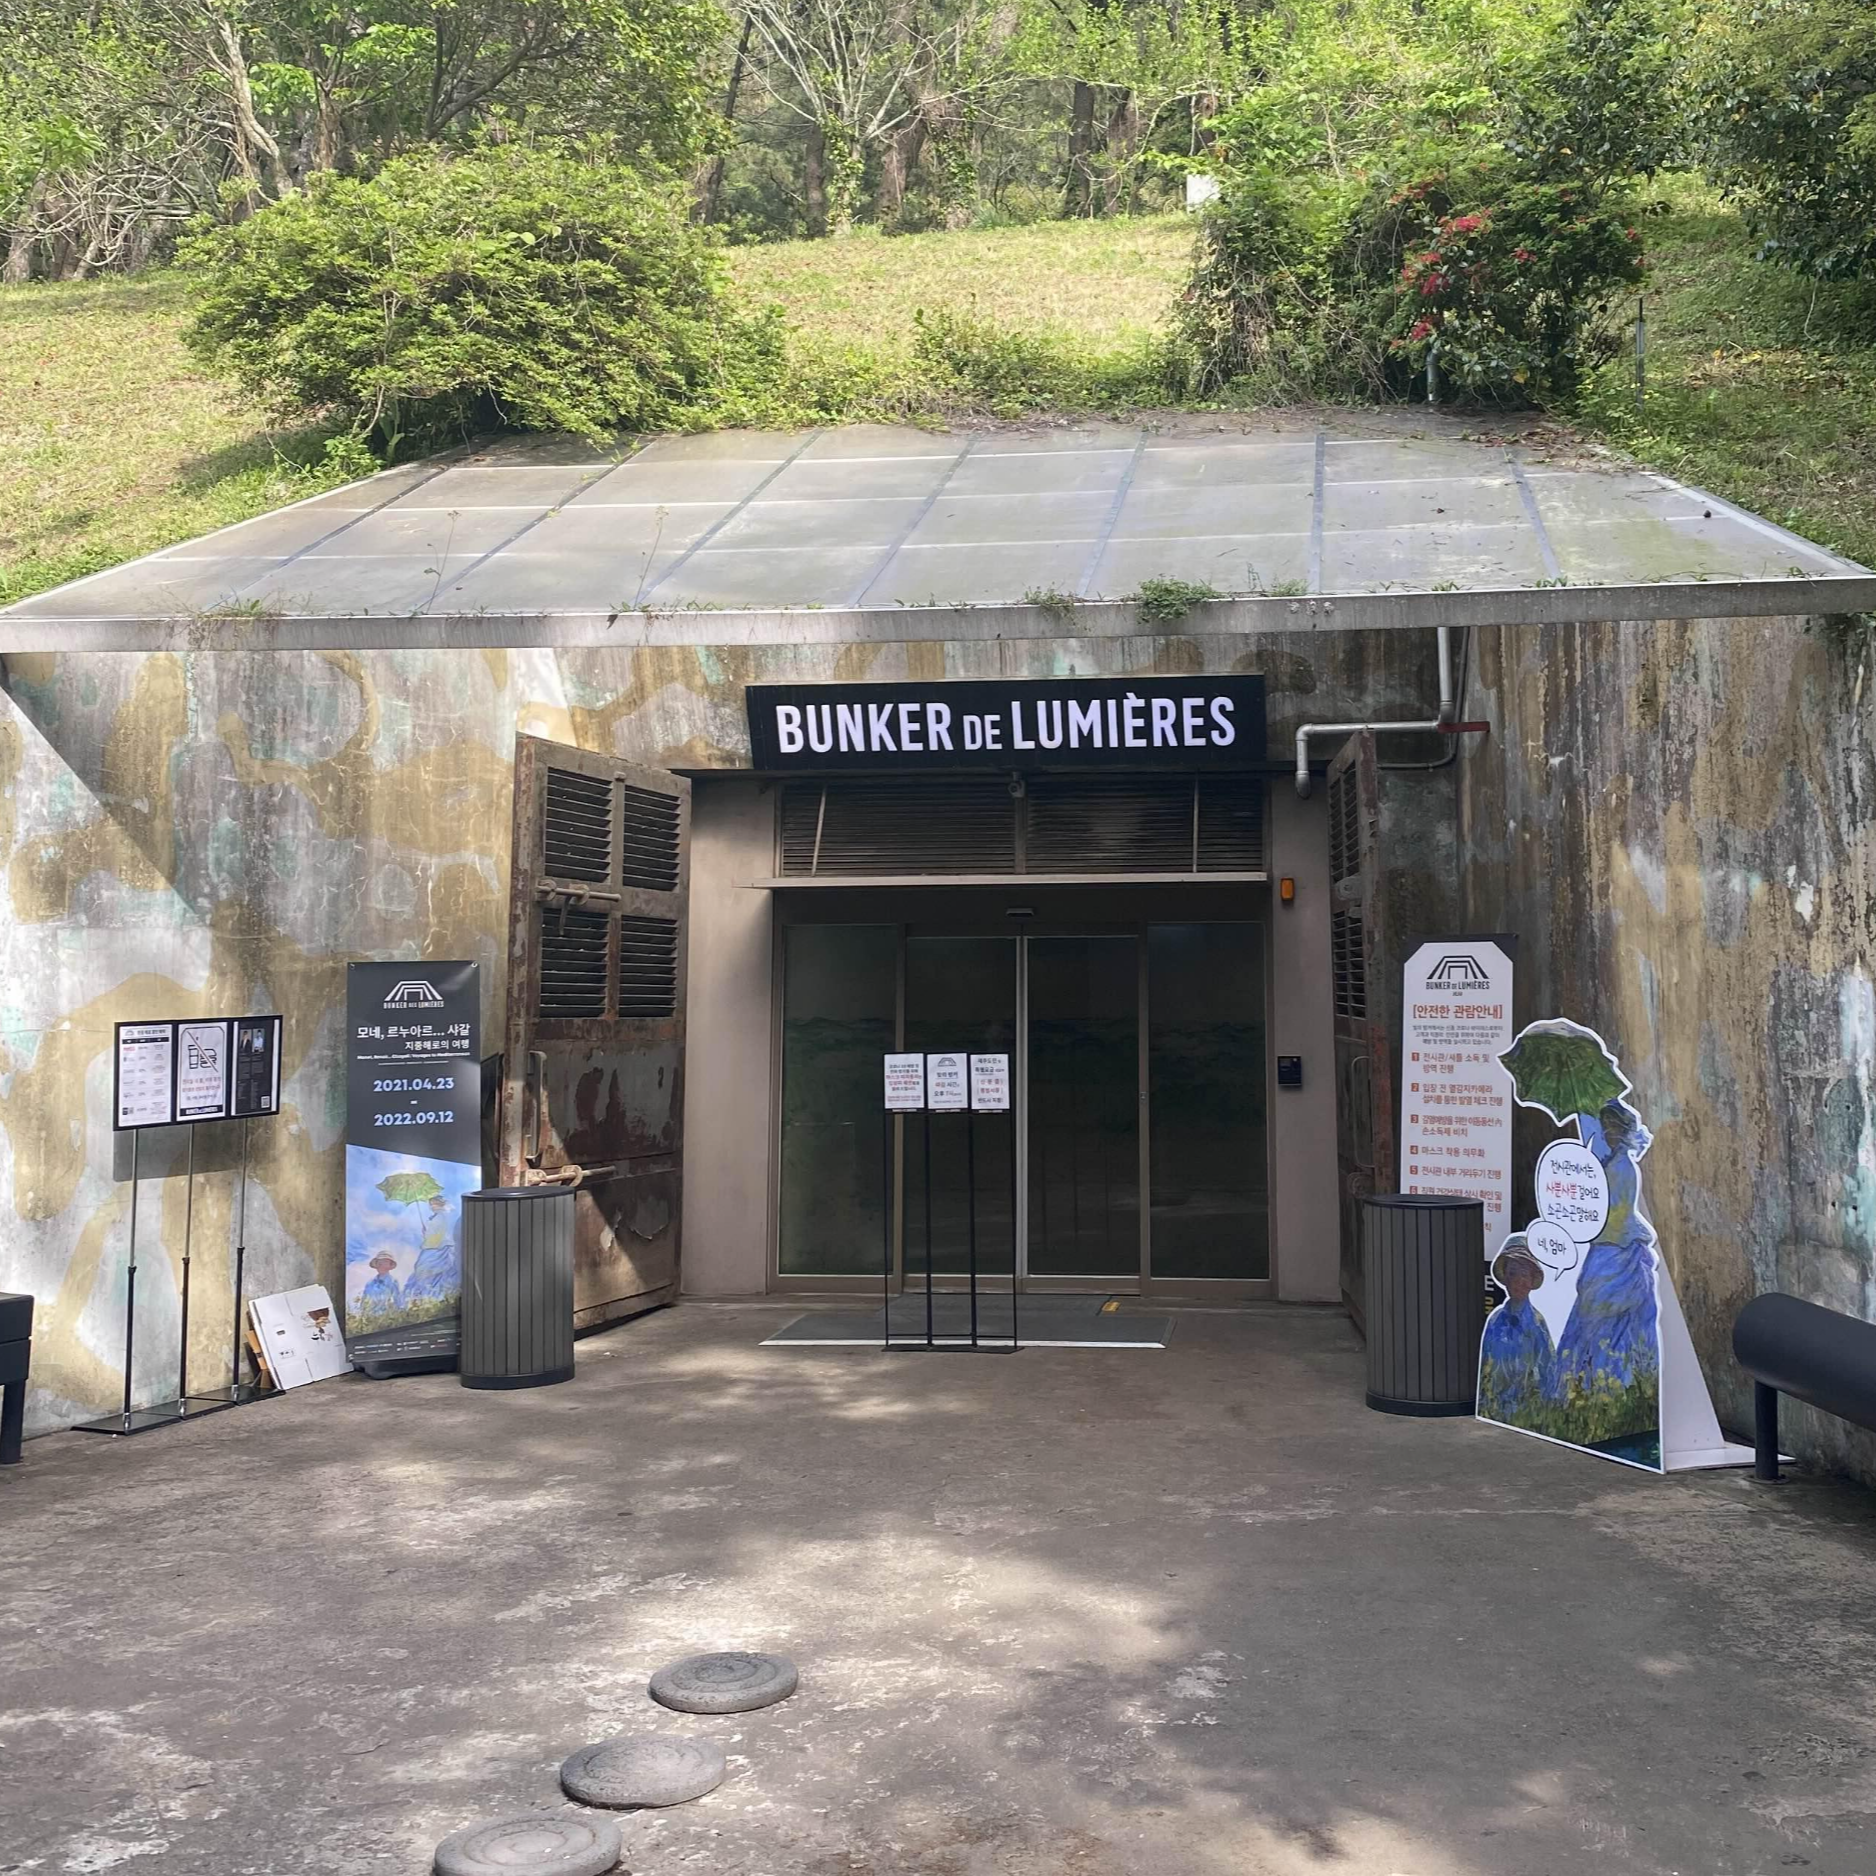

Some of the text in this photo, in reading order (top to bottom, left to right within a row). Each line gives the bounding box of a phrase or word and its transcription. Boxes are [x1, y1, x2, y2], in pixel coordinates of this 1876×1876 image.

[775, 692, 1236, 753] BUNKER DE LUMIÈRES
[1426, 982, 1450, 990] BUNKER
[1458, 980, 1490, 990] LUMIÈRES
[1413, 1004, 1503, 1020] [안전한 관람안내]
[357, 1023, 471, 1040] 모네, 르누아르... 샤갈
[404, 1039, 470, 1050] 지중해로의 여행
[1465, 1053, 1480, 1063] 소독
[1482, 1054, 1490, 1063] 및
[1439, 1064, 1454, 1074] 진행
[373, 1077, 454, 1092] 2021.04.23
[1423, 1084, 1437, 1092] 입장
[1488, 1096, 1503, 1106] 진행
[374, 1111, 454, 1126] 2022.09.12
[1422, 1126, 1468, 1137] 손소독제 비치
[1421, 1146, 1443, 1155] 마스크
[1446, 1147, 1460, 1157] 착용
[1421, 1166, 1442, 1176] 전시관
[1443, 1167, 1457, 1177] 내부
[1459, 1168, 1486, 1178] 거리두기
[1487, 1170, 1502, 1179] 진행
[1551, 1160, 1596, 1179] 전시관에서는,
[1487, 1202, 1502, 1212] 진행
[1549, 1239, 1566, 1255] 엄마
